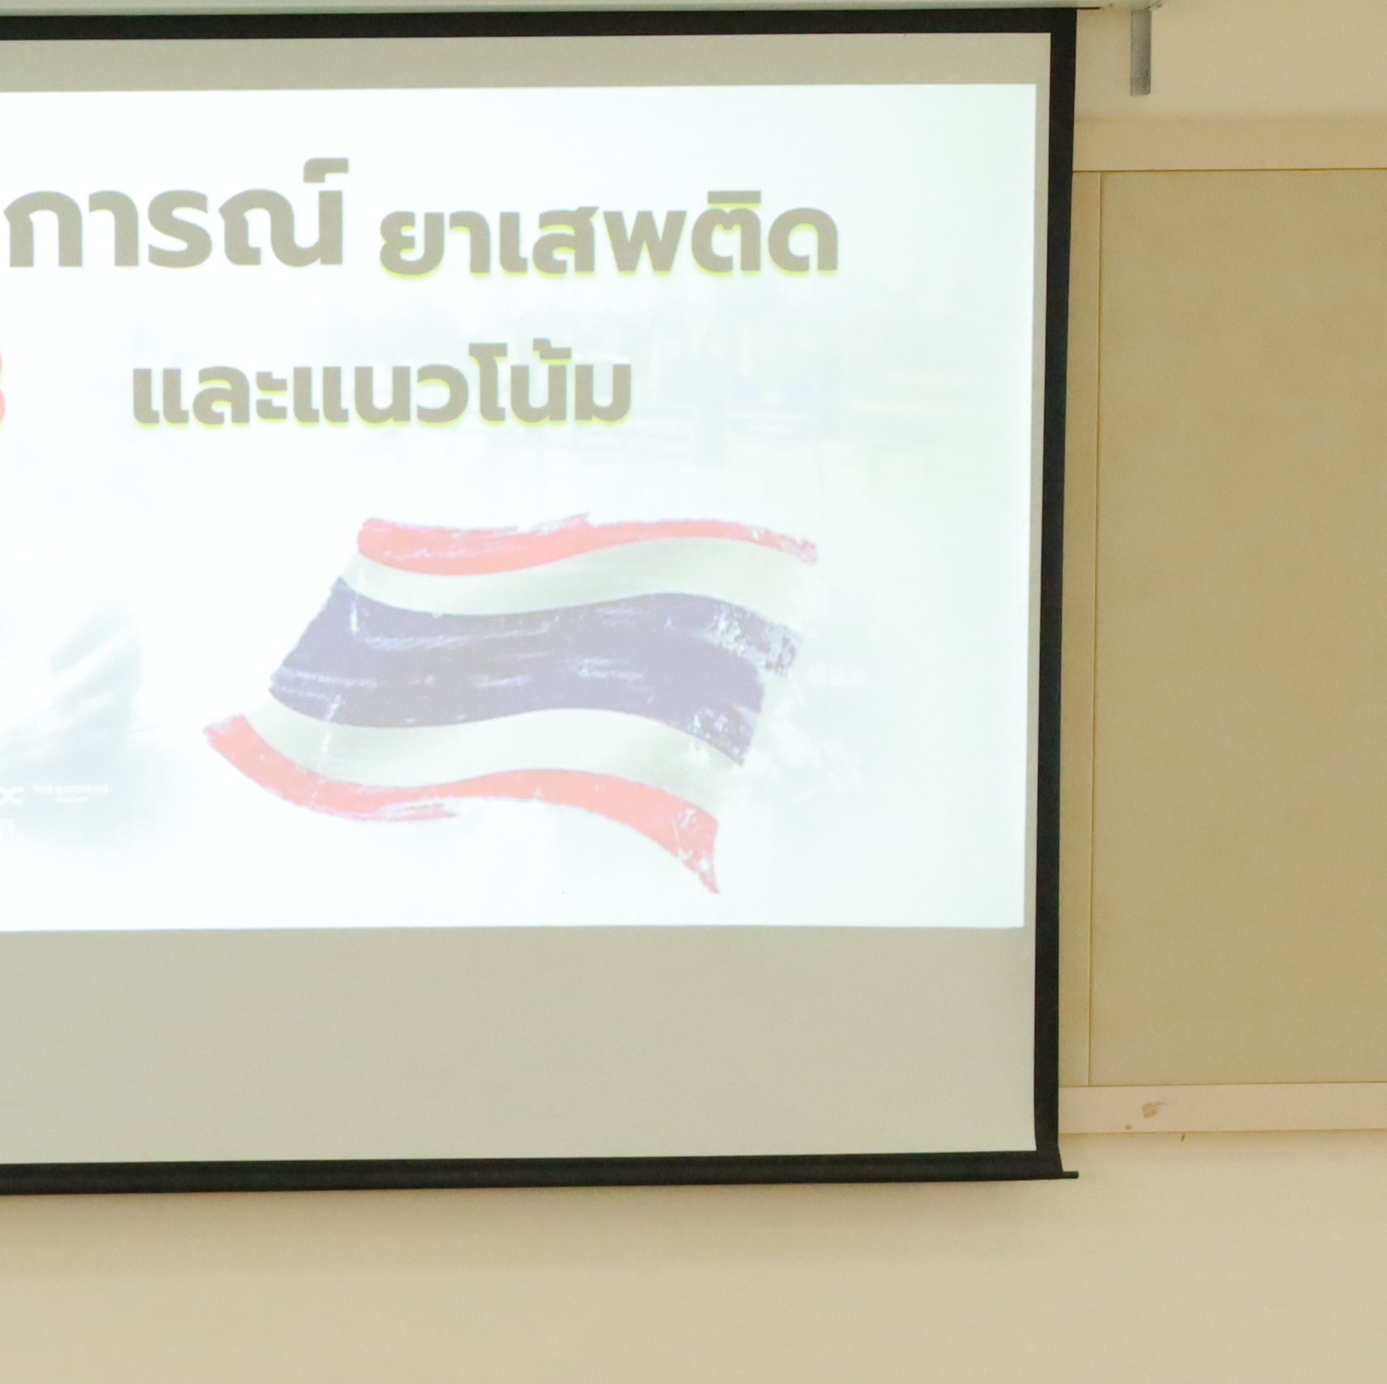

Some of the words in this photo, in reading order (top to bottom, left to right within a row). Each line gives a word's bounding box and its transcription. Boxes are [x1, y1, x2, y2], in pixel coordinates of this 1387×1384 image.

[379, 189, 840, 277] ยาเสพติด
[132, 338, 633, 427] และแนวโน้ม
